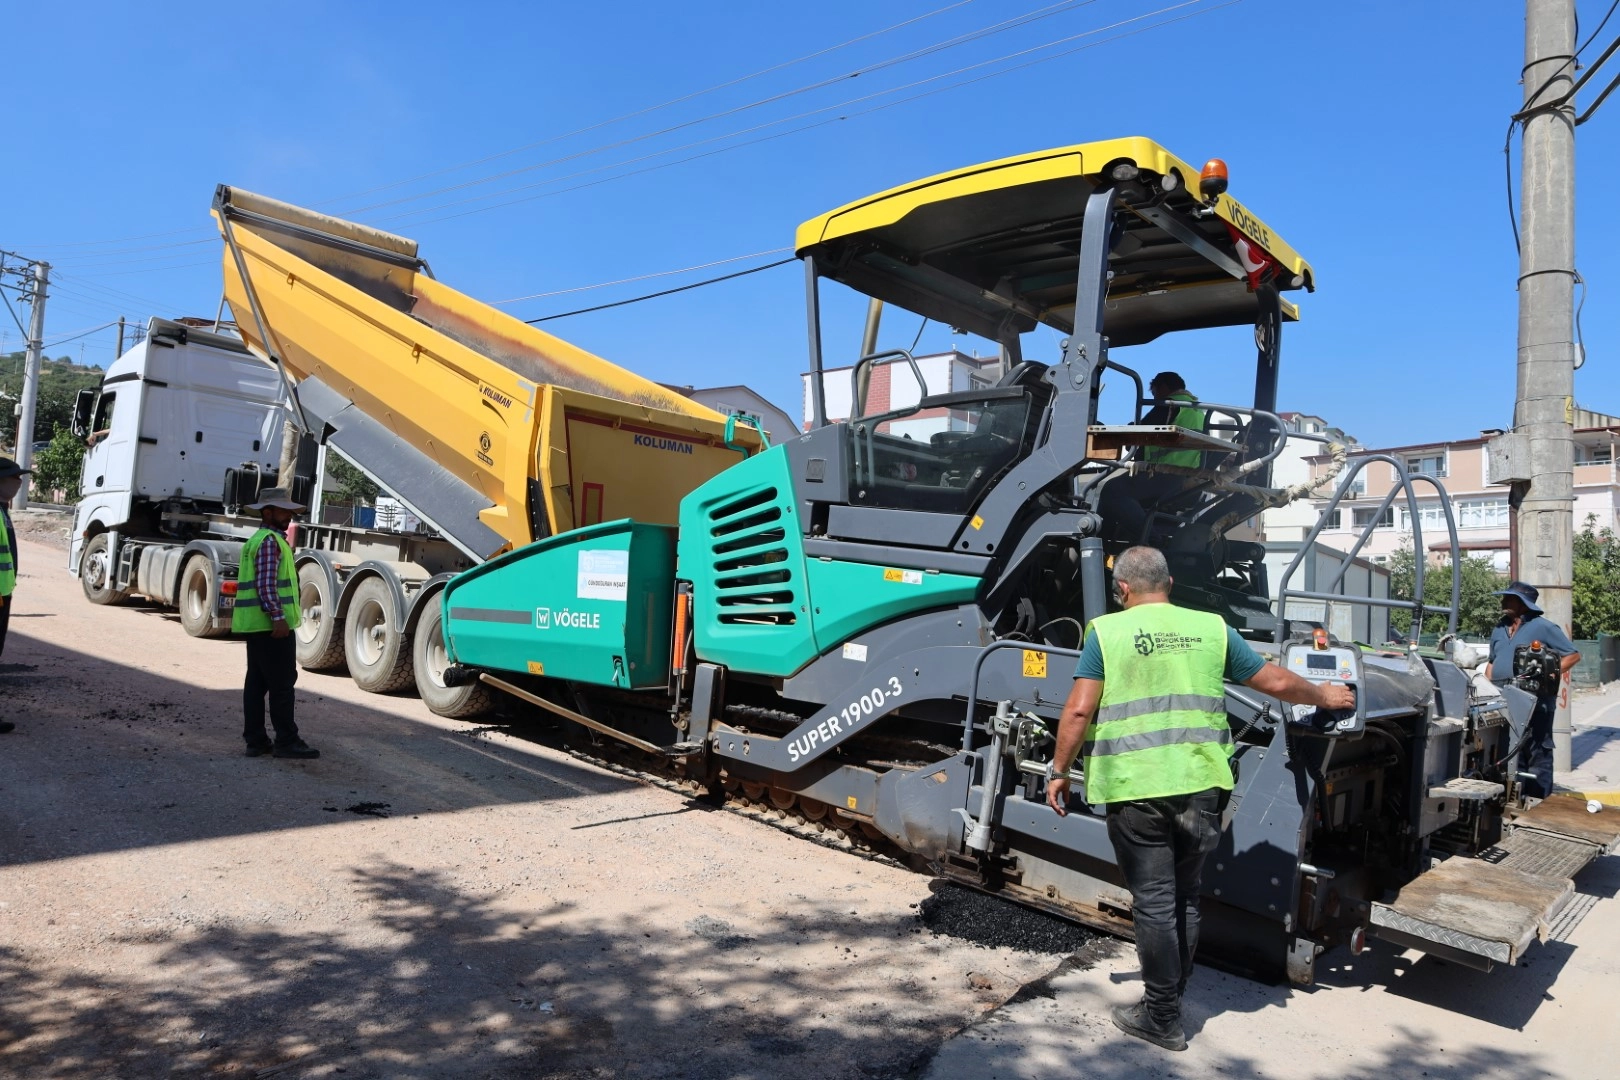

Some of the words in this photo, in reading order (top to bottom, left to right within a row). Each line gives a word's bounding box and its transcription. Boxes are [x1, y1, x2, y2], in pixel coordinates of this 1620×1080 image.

[1226, 200, 1271, 250] VÖGELE
[482, 386, 512, 408] KOLUMAN
[634, 434, 693, 454] KOLUMAN
[553, 607, 600, 629] VÖGELE
[787, 716, 843, 762] SUPER
[841, 676, 903, 726] 1900-3
